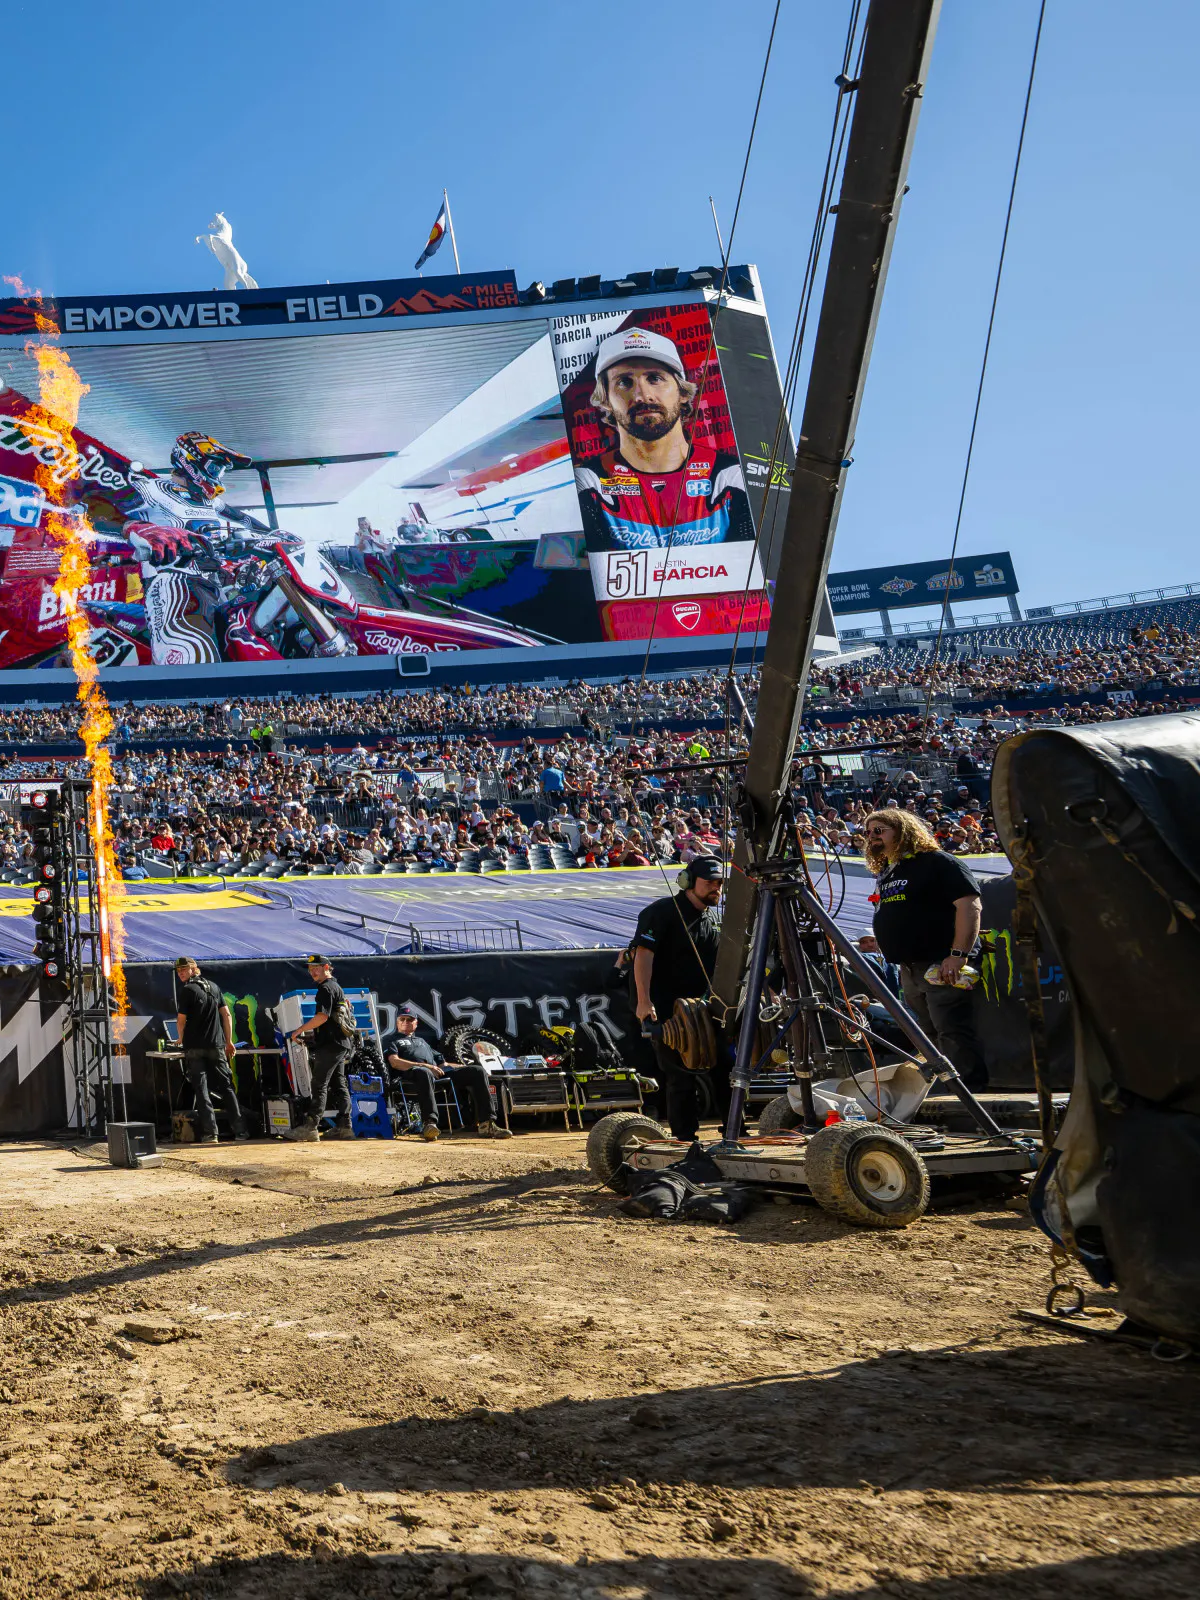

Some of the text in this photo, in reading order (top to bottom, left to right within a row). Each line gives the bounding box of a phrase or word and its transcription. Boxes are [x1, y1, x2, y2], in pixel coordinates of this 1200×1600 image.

[461, 285, 474, 296] AT
[474, 281, 515, 296] MILE
[476, 293, 519, 309] HIGH
[64, 293, 384, 333] EMPOWER FIELD
[554, 327, 592, 346] BARCIA
[665, 526, 720, 546] Designs
[655, 560, 687, 569] JUSTIN
[606, 551, 648, 598] 51
[653, 564, 728, 583] BARCIA
[974, 567, 1006, 587] 50
[828, 583, 871, 594] SUPER BOWL
[831, 591, 871, 603] CHAMPIONS
[1030, 608, 1049, 618] 235
[396, 735, 438, 744] EMPOWER
